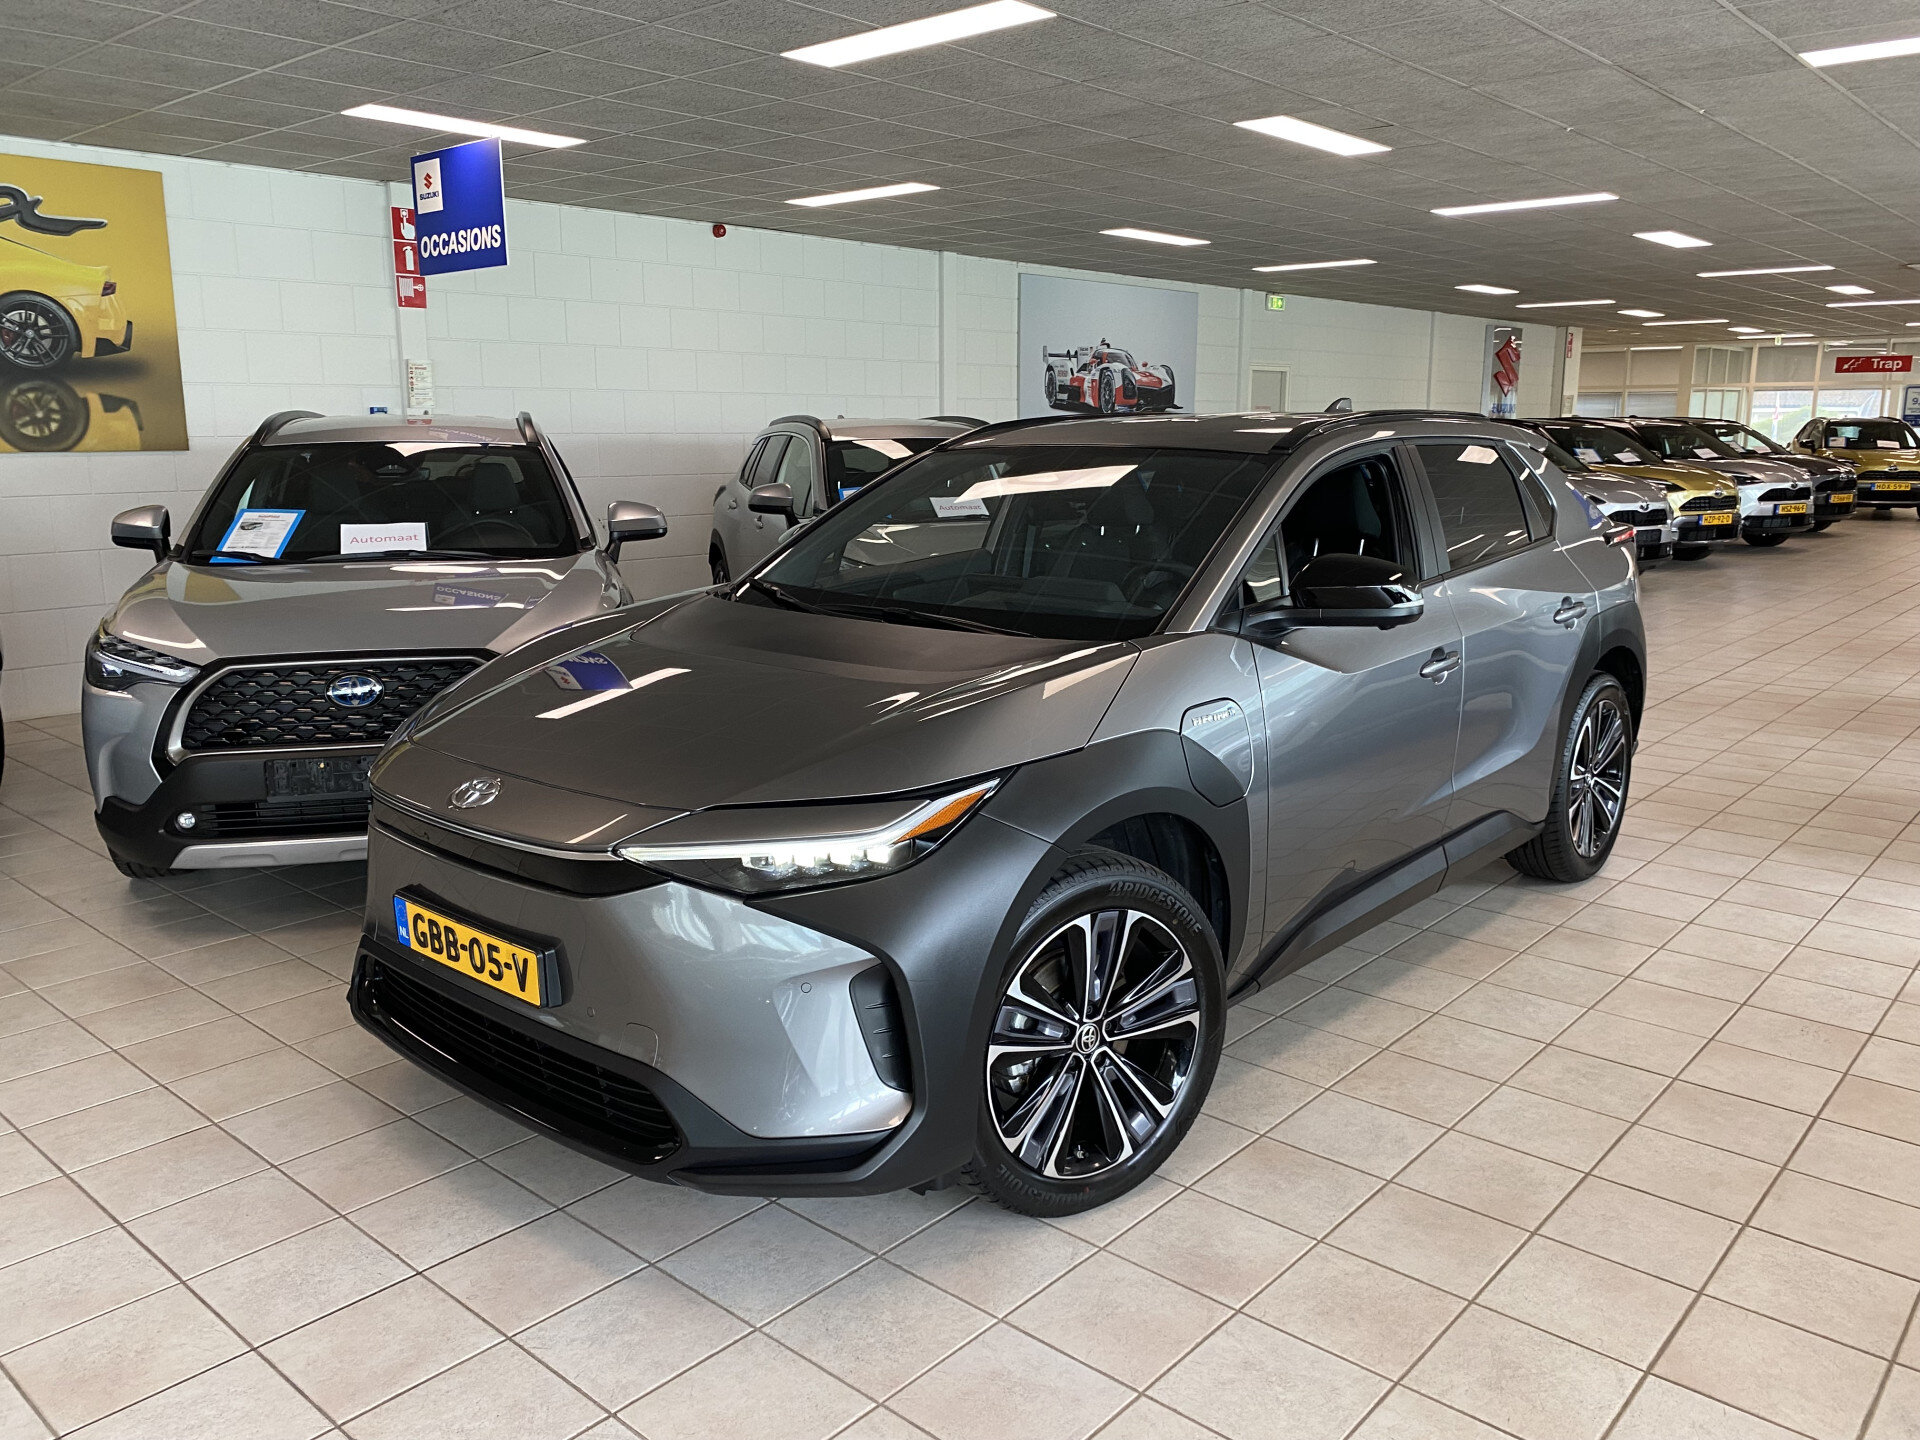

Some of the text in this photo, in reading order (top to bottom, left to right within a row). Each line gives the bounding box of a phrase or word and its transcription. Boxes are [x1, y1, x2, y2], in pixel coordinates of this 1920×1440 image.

[420, 191, 439, 201] SUZUKI
[421, 224, 501, 258] OCCASIONS
[1872, 358, 1902, 371] Trap
[350, 533, 419, 545] Automaat
[1109, 881, 1202, 934] BRIDGESTONE
[400, 926, 409, 939] NL
[412, 912, 528, 993] GBB-05-V
